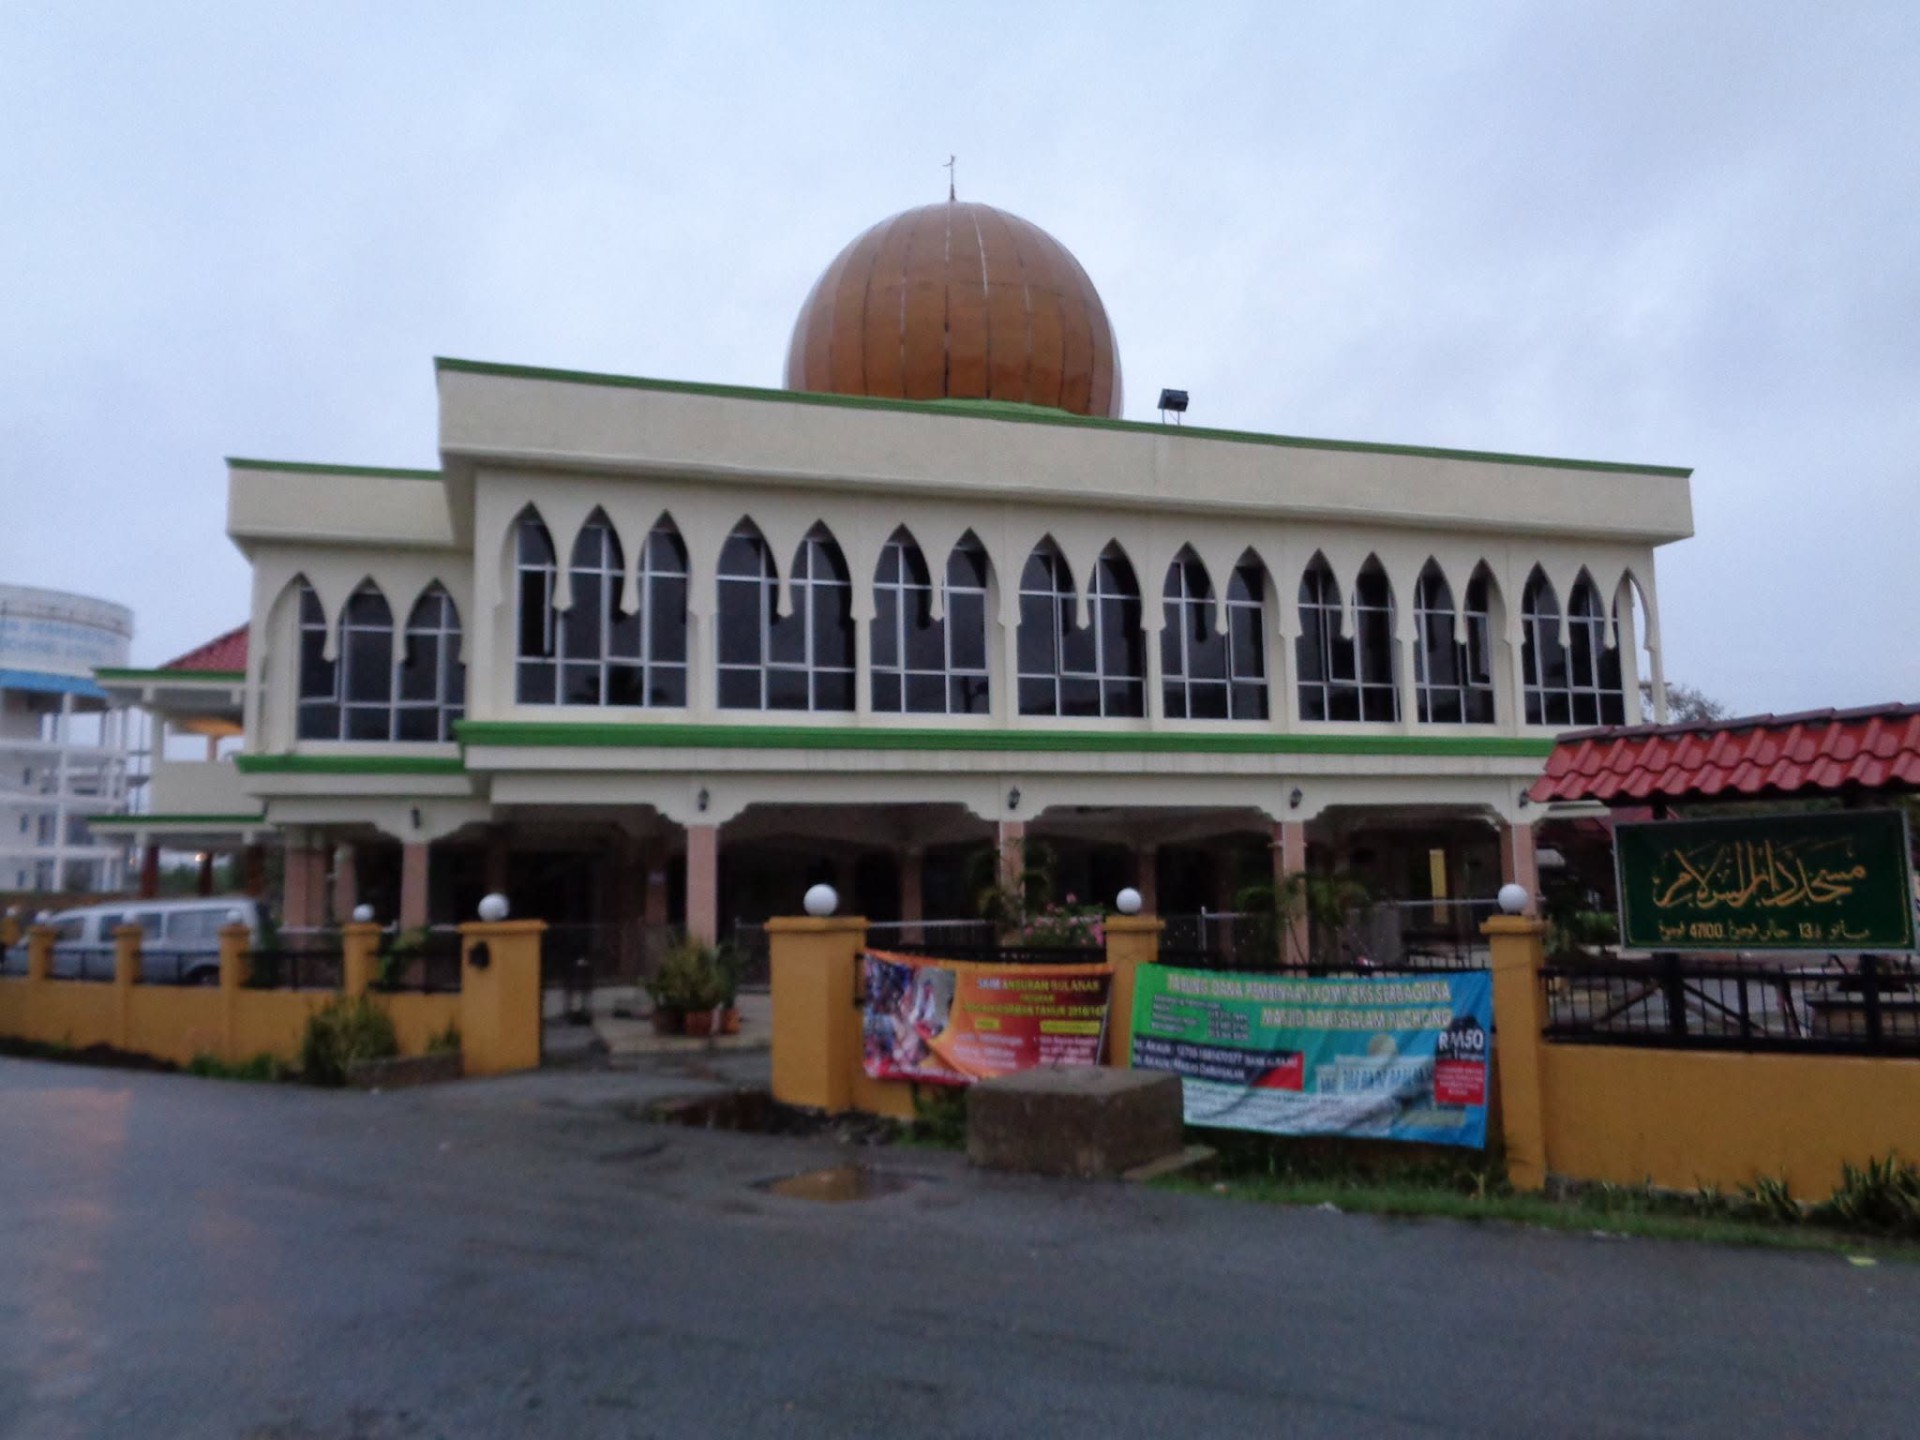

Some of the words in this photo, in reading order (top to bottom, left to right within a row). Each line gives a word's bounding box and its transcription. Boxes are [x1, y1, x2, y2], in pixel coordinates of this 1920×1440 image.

[1211, 978, 1243, 998] DANA
[1375, 981, 1450, 1003] SERBAGUNA
[1262, 1007, 1304, 1027] MASJID
[1308, 1009, 1386, 1029] DARUSSALAM
[1390, 1009, 1451, 1029] PUCHONG
[1438, 1029, 1484, 1050] RM50
